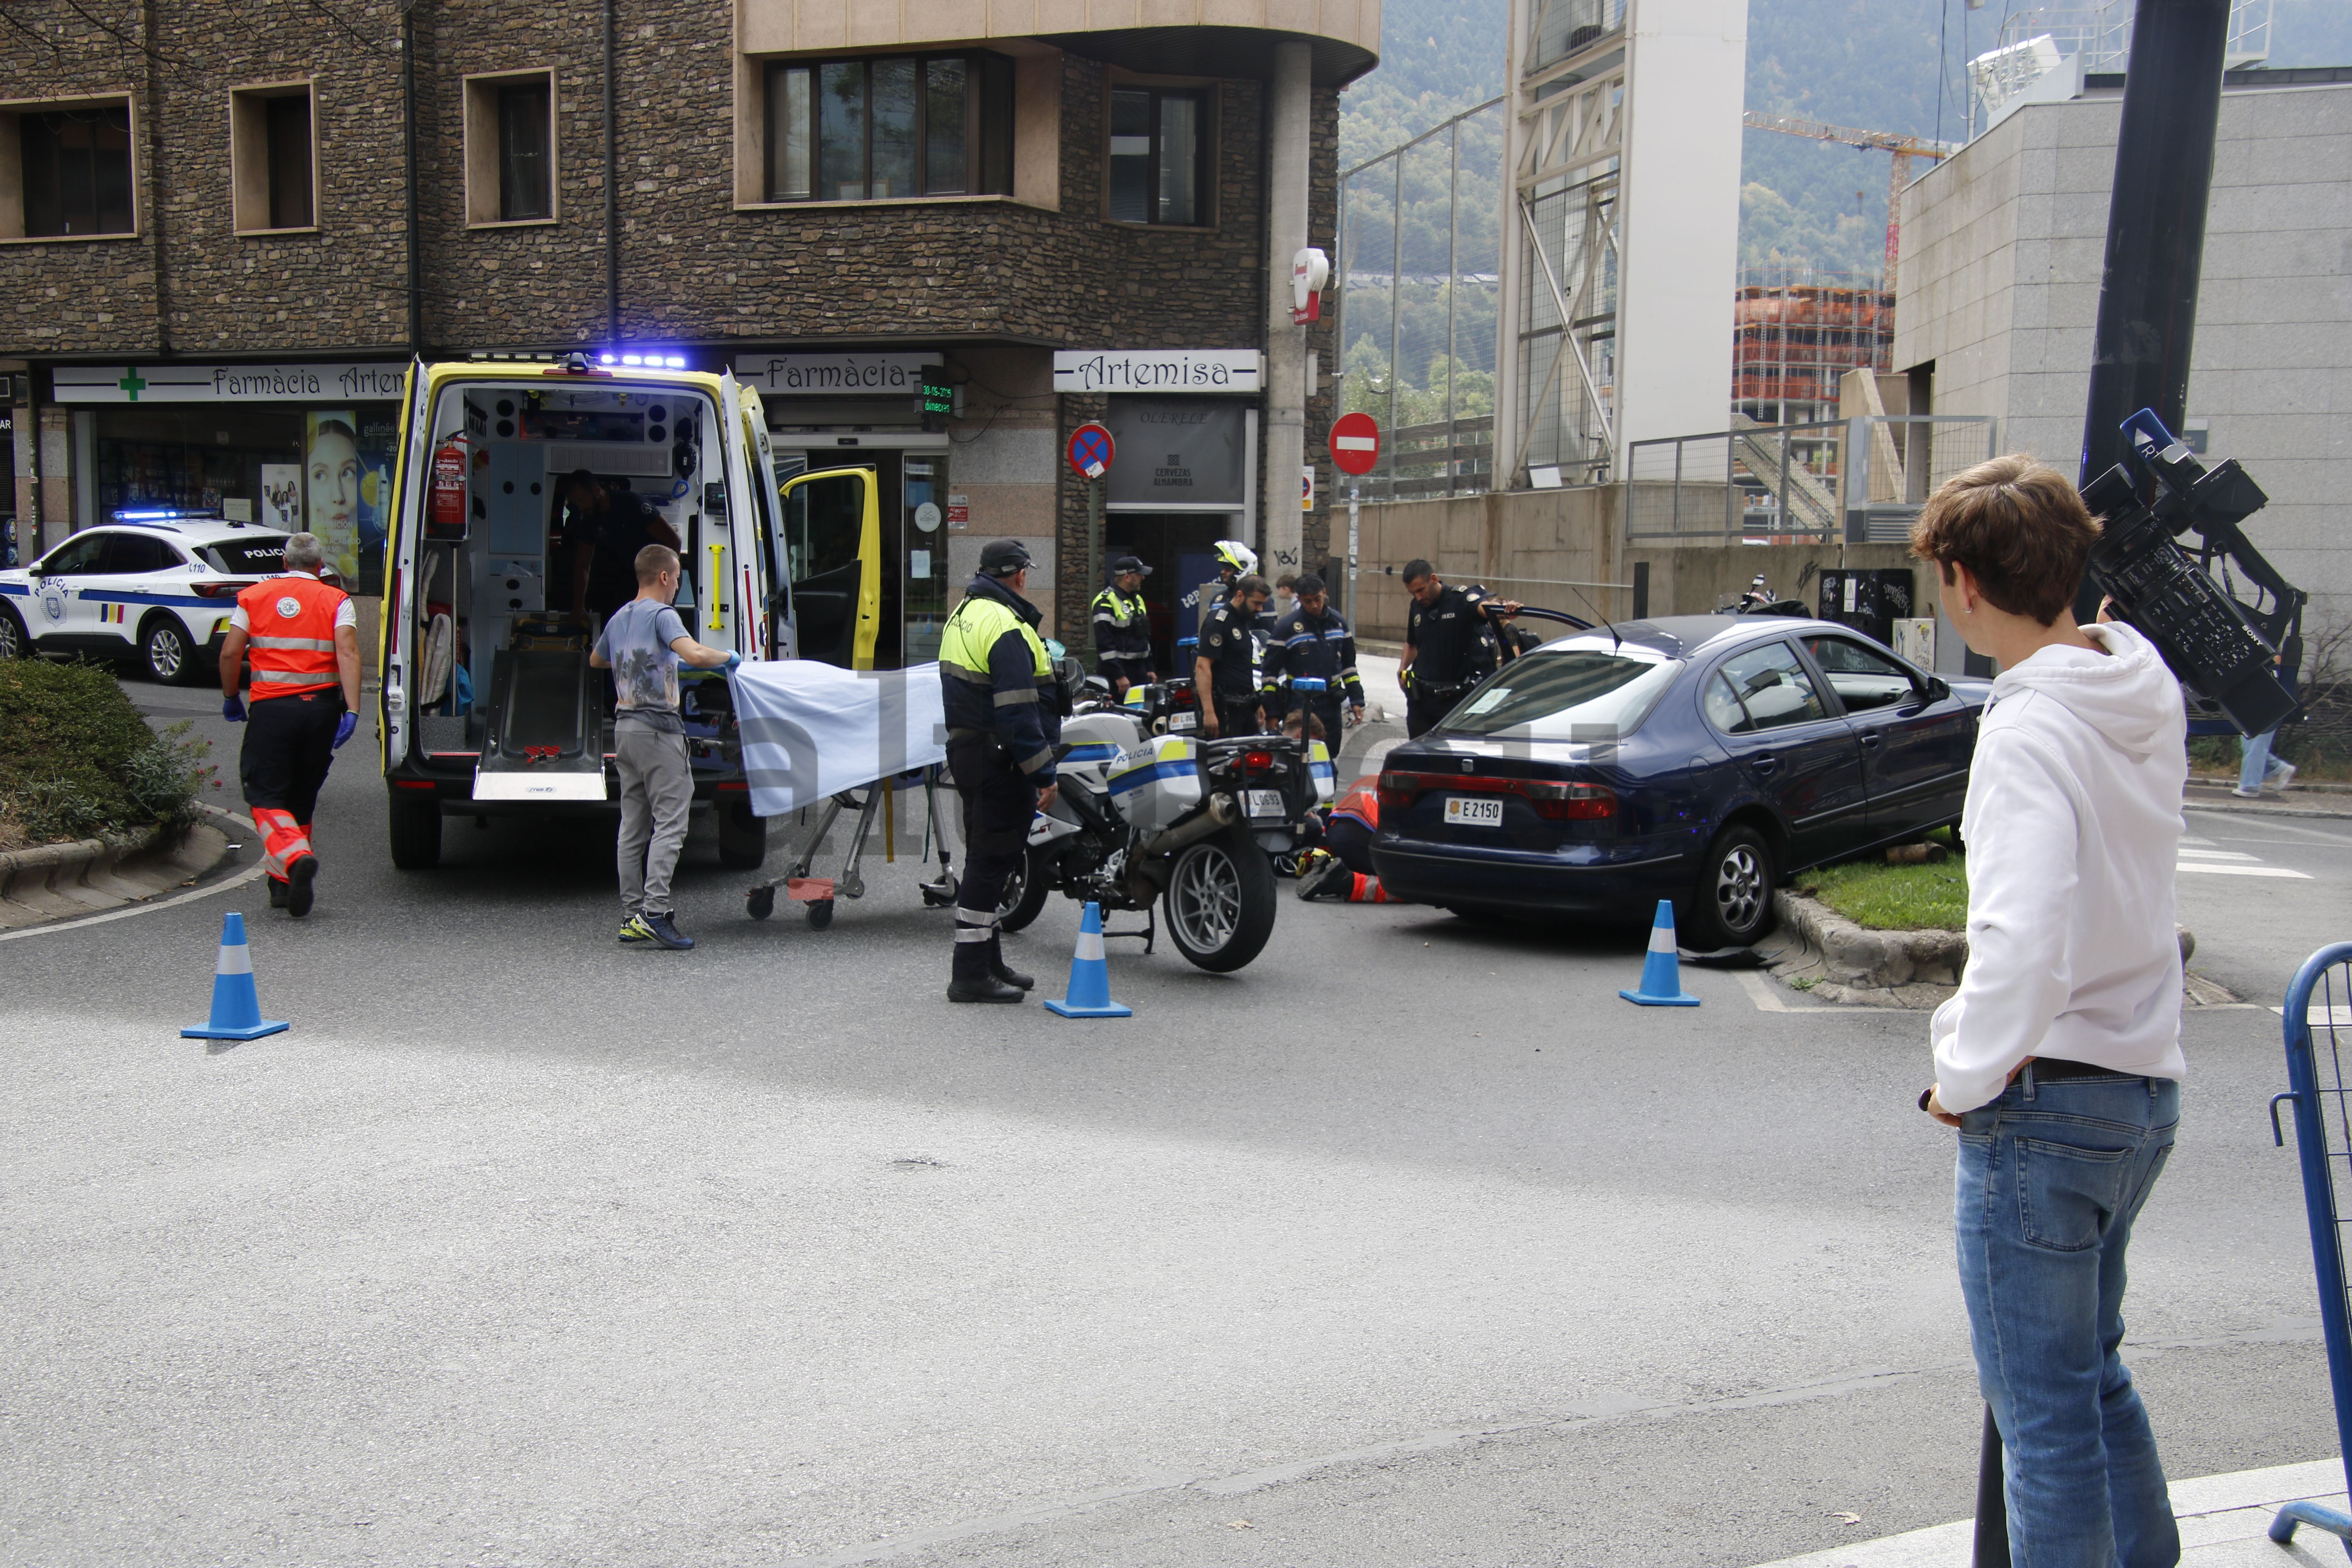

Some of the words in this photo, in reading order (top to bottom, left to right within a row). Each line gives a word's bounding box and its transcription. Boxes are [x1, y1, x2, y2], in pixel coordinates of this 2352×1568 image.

[212, 367, 321, 396] Farmàcia
[767, 358, 905, 388] Farmàcia
[1079, 355, 1229, 391] Artemisa
[364, 422, 395, 437] gallinée
[1140, 412, 1208, 425] OLERELE
[192, 563, 206, 573] 110
[34, 577, 69, 599] POLICIA
[2242, 624, 2263, 646] SONY
[1116, 748, 1153, 764] POLICIA
